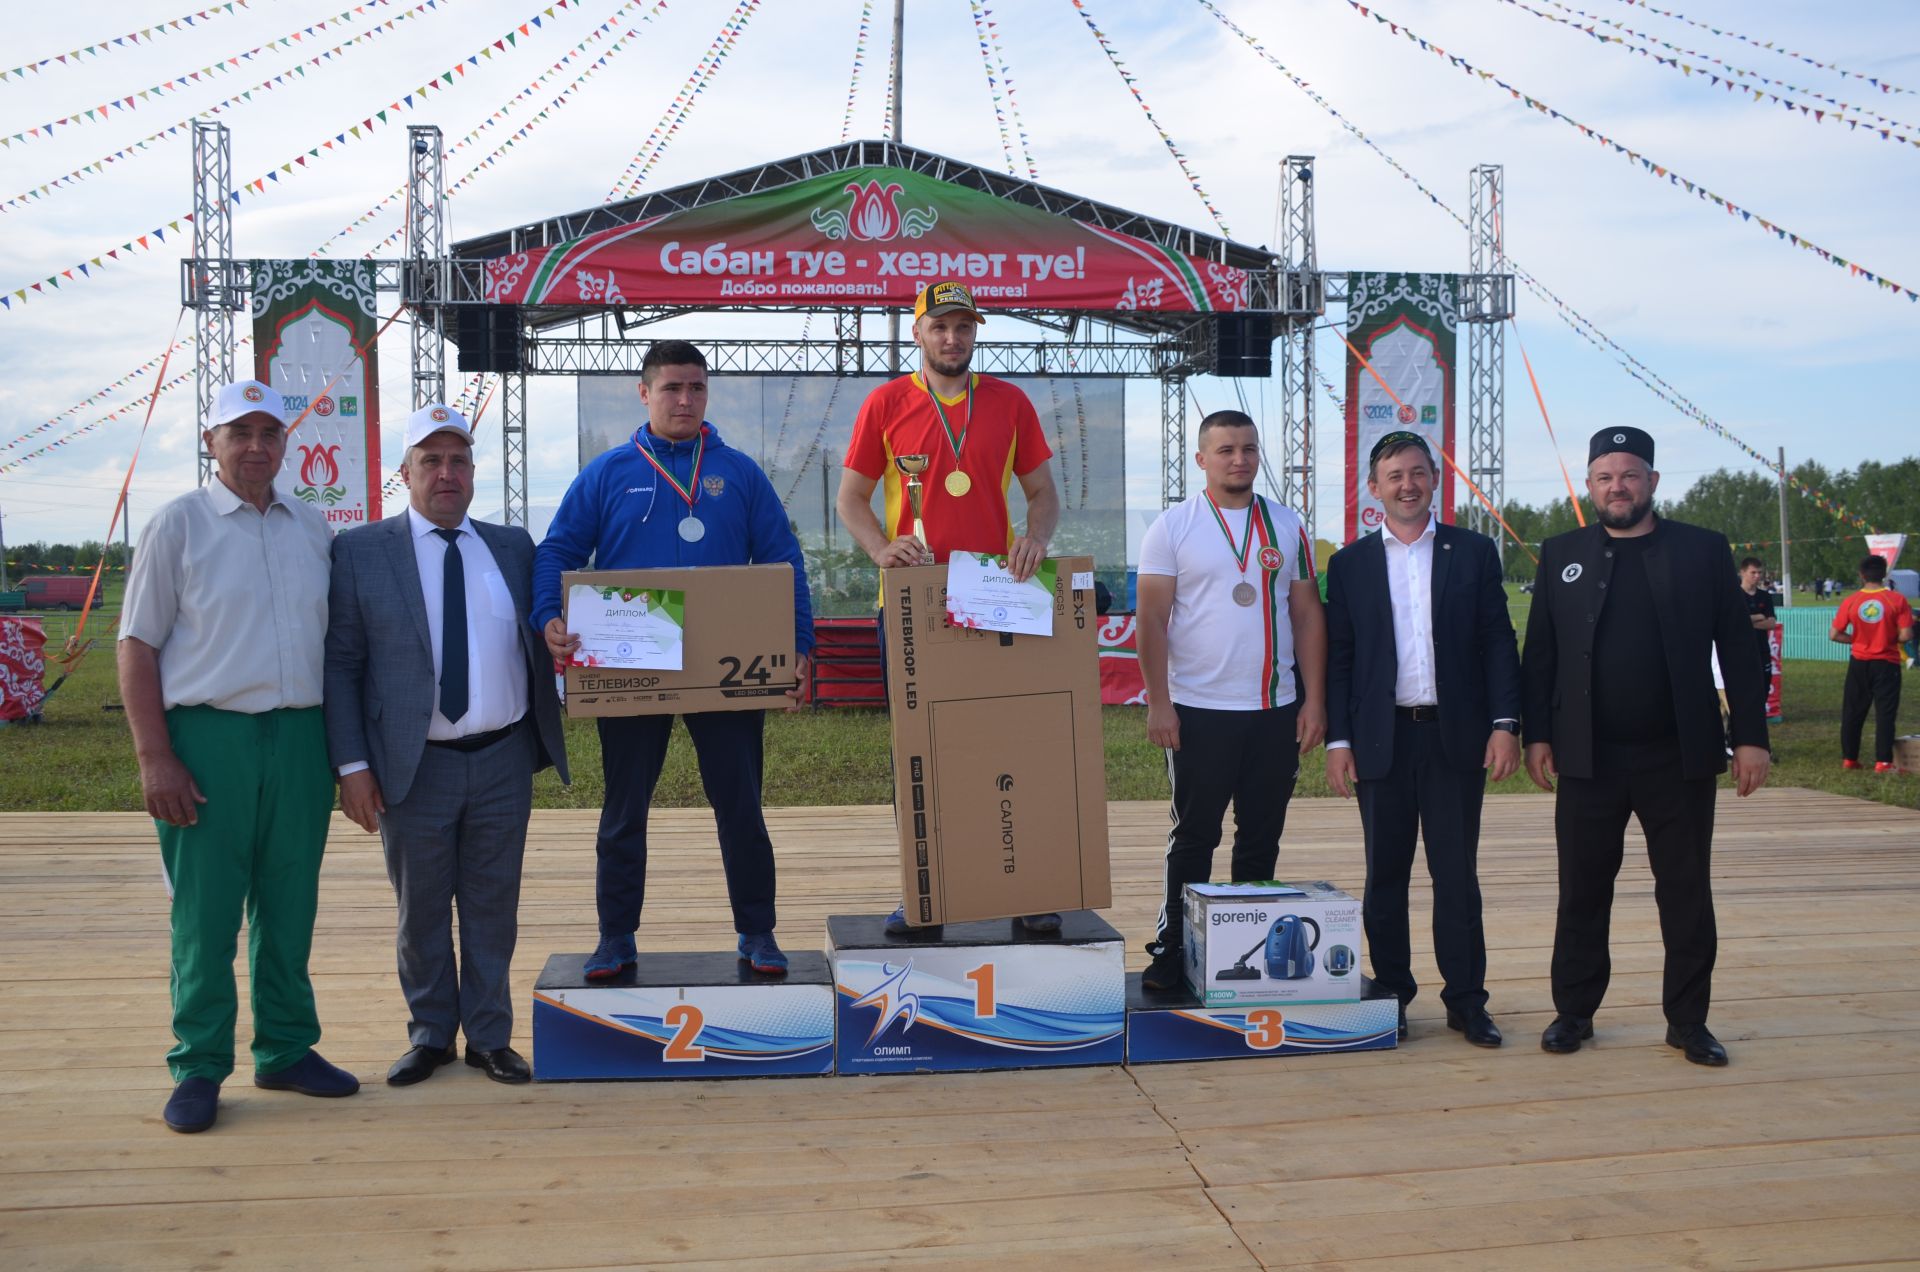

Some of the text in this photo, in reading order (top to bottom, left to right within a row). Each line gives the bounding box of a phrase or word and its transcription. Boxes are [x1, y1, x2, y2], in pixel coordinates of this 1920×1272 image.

[660, 241, 774, 275] Сабан
[786, 250, 846, 278] туе
[877, 251, 1007, 278] хезмәт
[1016, 246, 1086, 281] туе!
[720, 280, 777, 296] Добро
[781, 280, 887, 296] пожаловать!
[971, 283, 1028, 298] итегез!
[283, 396, 308, 411] 2024
[1369, 405, 1393, 418] 2024
[605, 609, 646, 617] ДИПЛОМ
[1073, 589, 1085, 629] EXP
[900, 586, 917, 710] ТЕЛЕВИЗОР LED
[718, 654, 786, 687] 24"
[579, 677, 660, 690] ТЕЛЕВИЗОР
[1000, 799, 1015, 874] САЛЮТ ТВ
[1212, 909, 1267, 925] gorenje
[965, 963, 997, 1019] 1
[1209, 991, 1233, 999] 1400W
[663, 1005, 705, 1062] 2
[1246, 1010, 1284, 1048] 3
[874, 1047, 911, 1055] ОЛИМП
